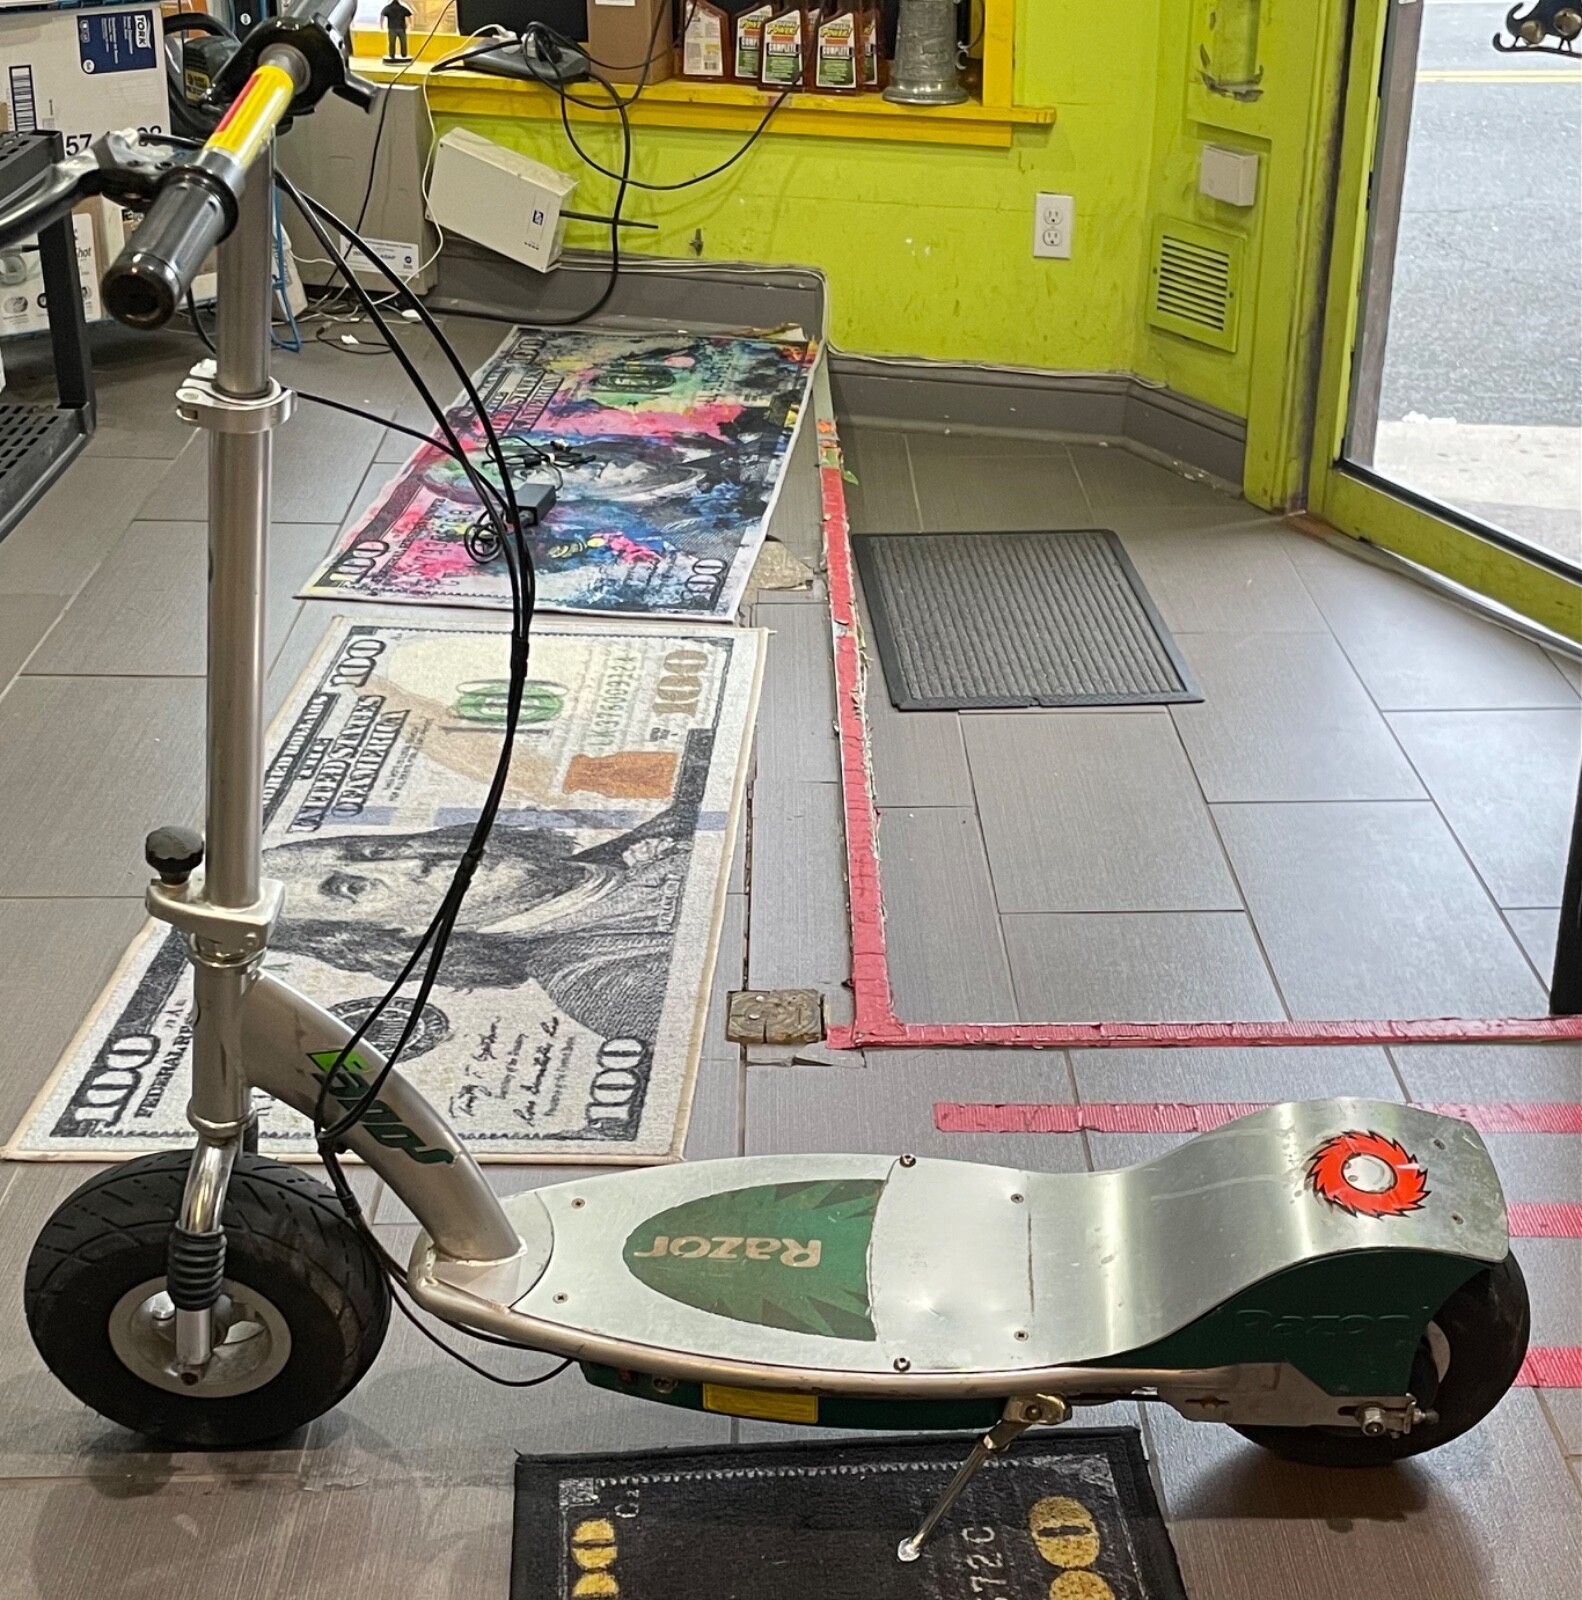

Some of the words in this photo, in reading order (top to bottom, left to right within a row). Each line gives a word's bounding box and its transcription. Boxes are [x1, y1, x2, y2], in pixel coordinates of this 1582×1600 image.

[136, 16, 147, 45] TORK
[741, 36, 760, 50] COMP
[767, 23, 799, 35] POWER!
[768, 43, 797, 56] COMPLETE
[820, 26, 853, 38] POWER!
[821, 46, 850, 58] COMPLETE
[66, 134, 92, 156] 57
[329, 540, 390, 584] 100
[330, 639, 387, 688] 100
[652, 650, 709, 717] 100
[287, 760, 352, 833] UNITED
[328, 695, 387, 758] STATES
[297, 738, 333, 779] THE
[349, 710, 410, 792] AMERICA
[74, 1034, 161, 1128] 100
[133, 1047, 187, 1118] FEDERAL
[586, 1036, 648, 1127] 100
[633, 1235, 822, 1268] Razor
